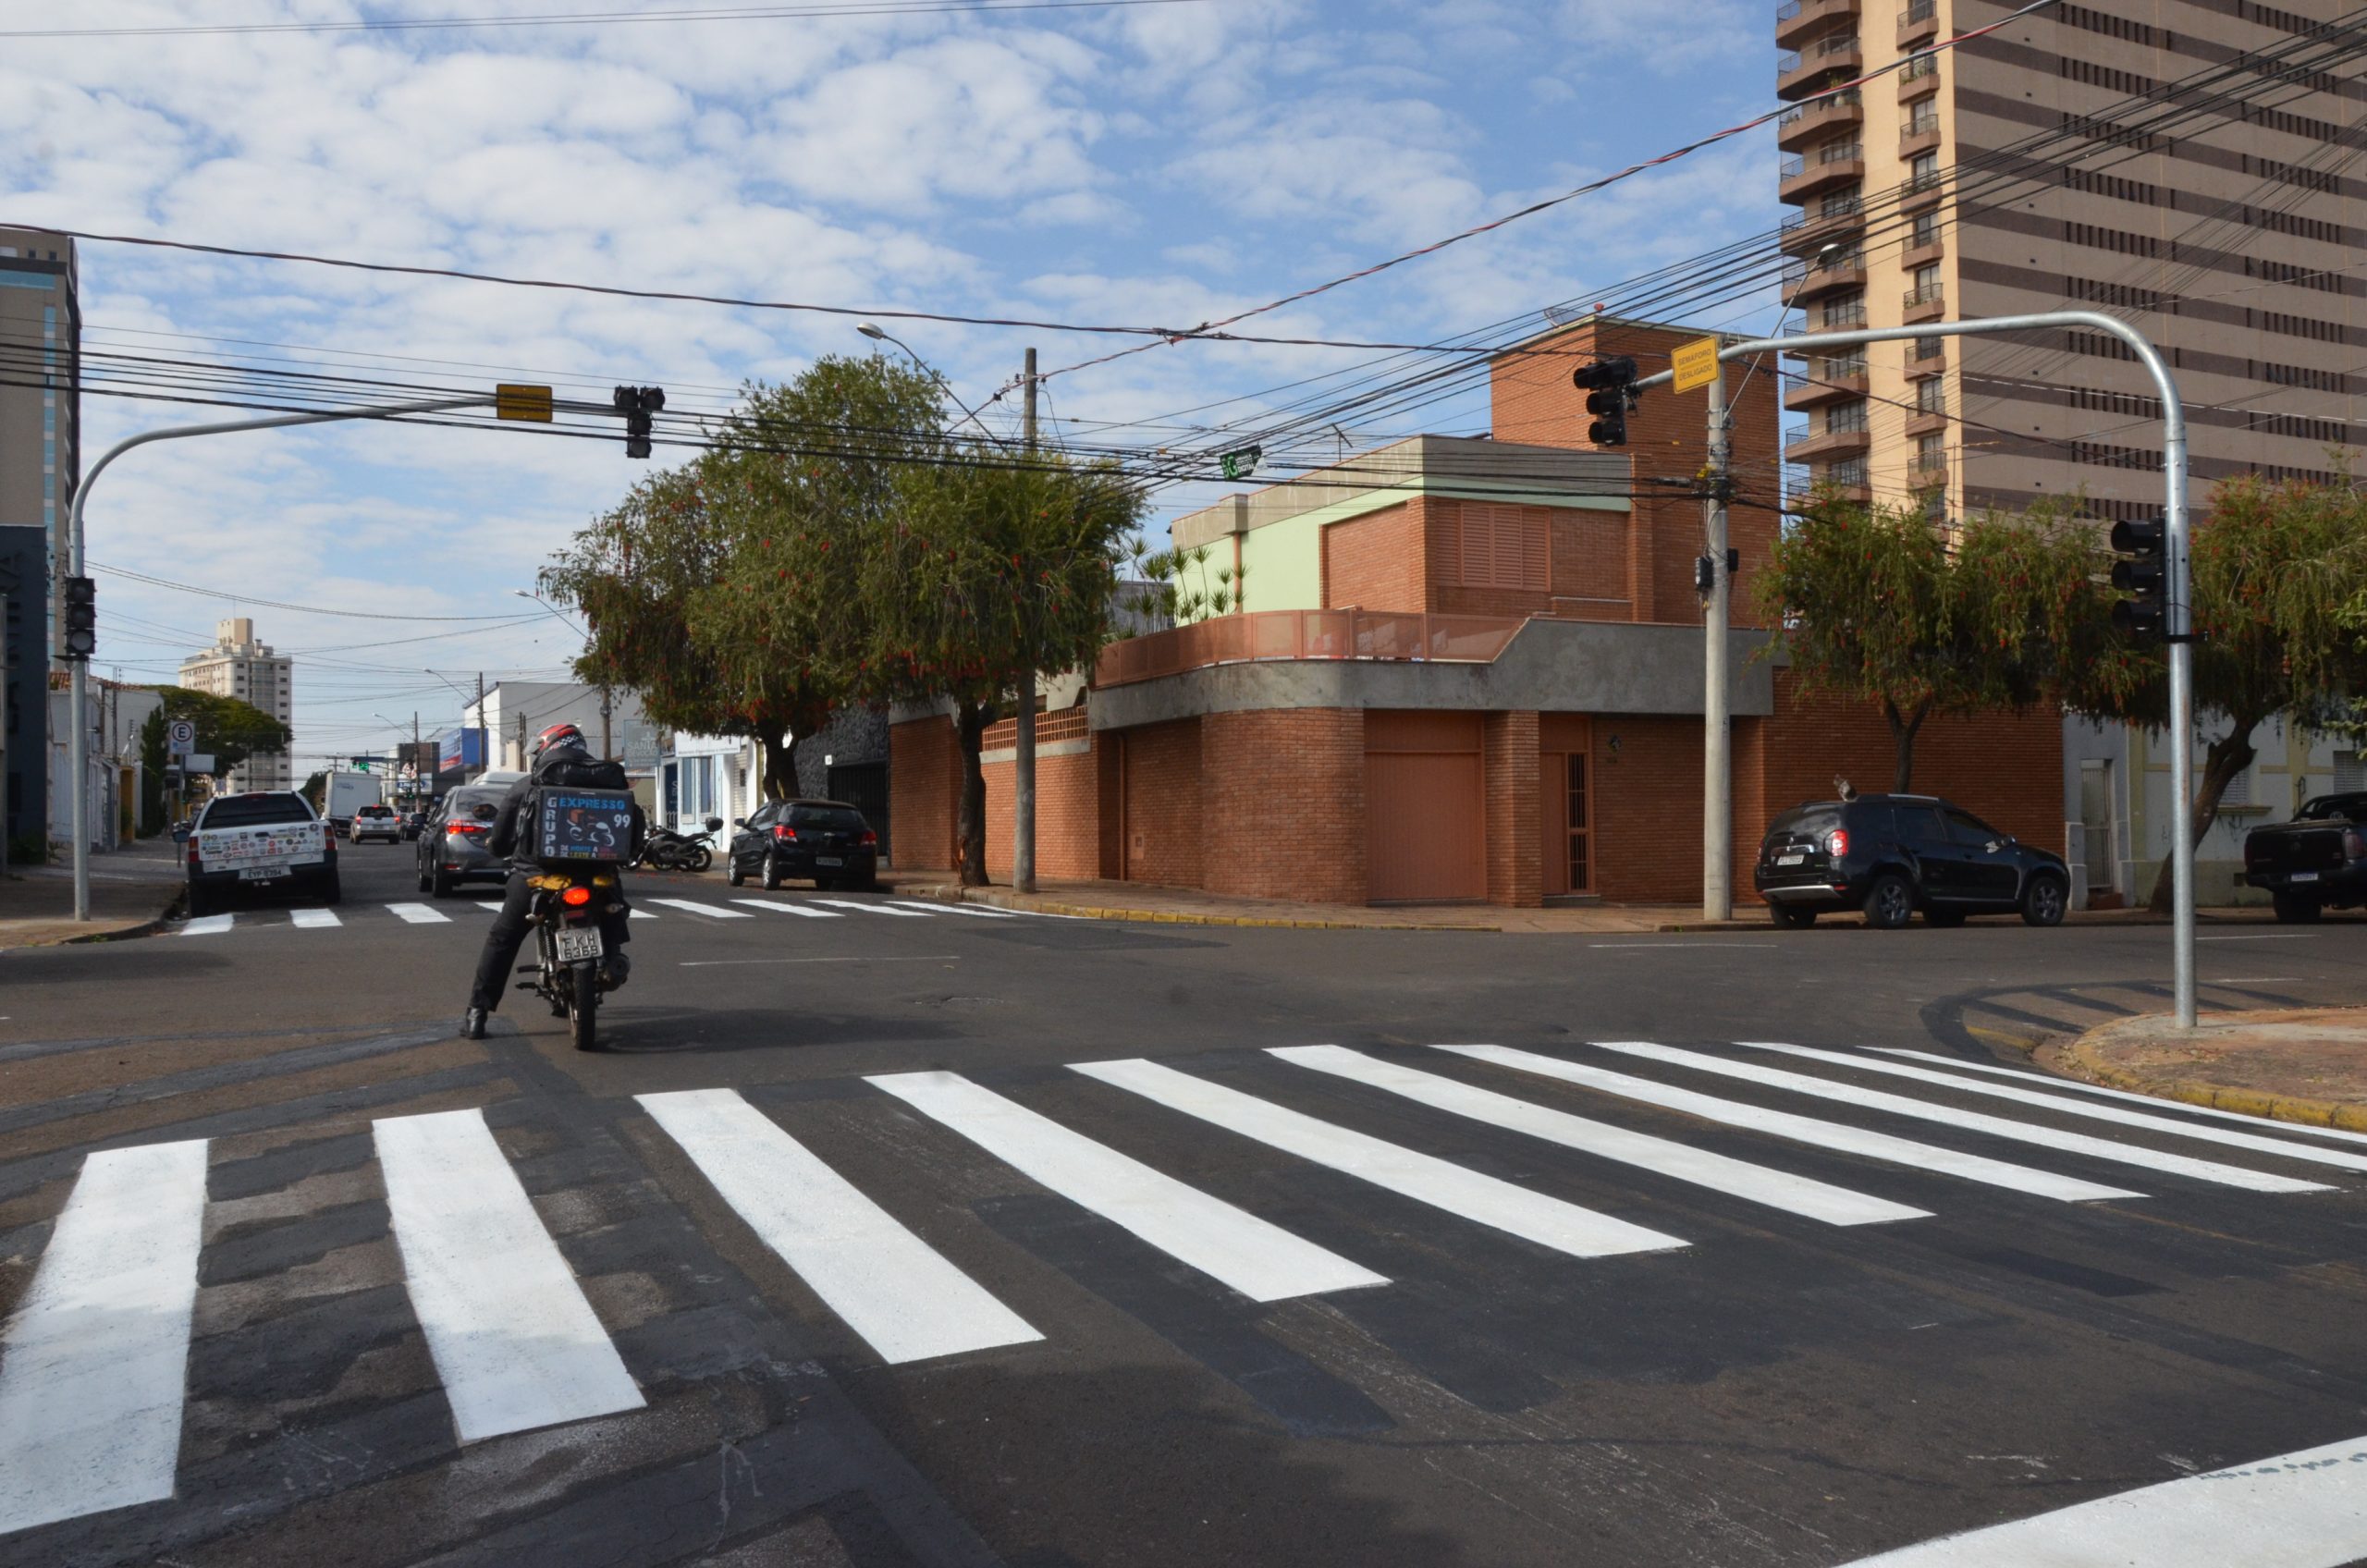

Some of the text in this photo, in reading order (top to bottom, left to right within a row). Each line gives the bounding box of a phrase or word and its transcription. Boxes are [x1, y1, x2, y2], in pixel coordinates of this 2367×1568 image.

[178, 727, 187, 738] E
[558, 798, 626, 810] EXPRESSO
[614, 815, 631, 828] 99
[562, 934, 595, 948] FKH
[564, 945, 598, 959] 6369
